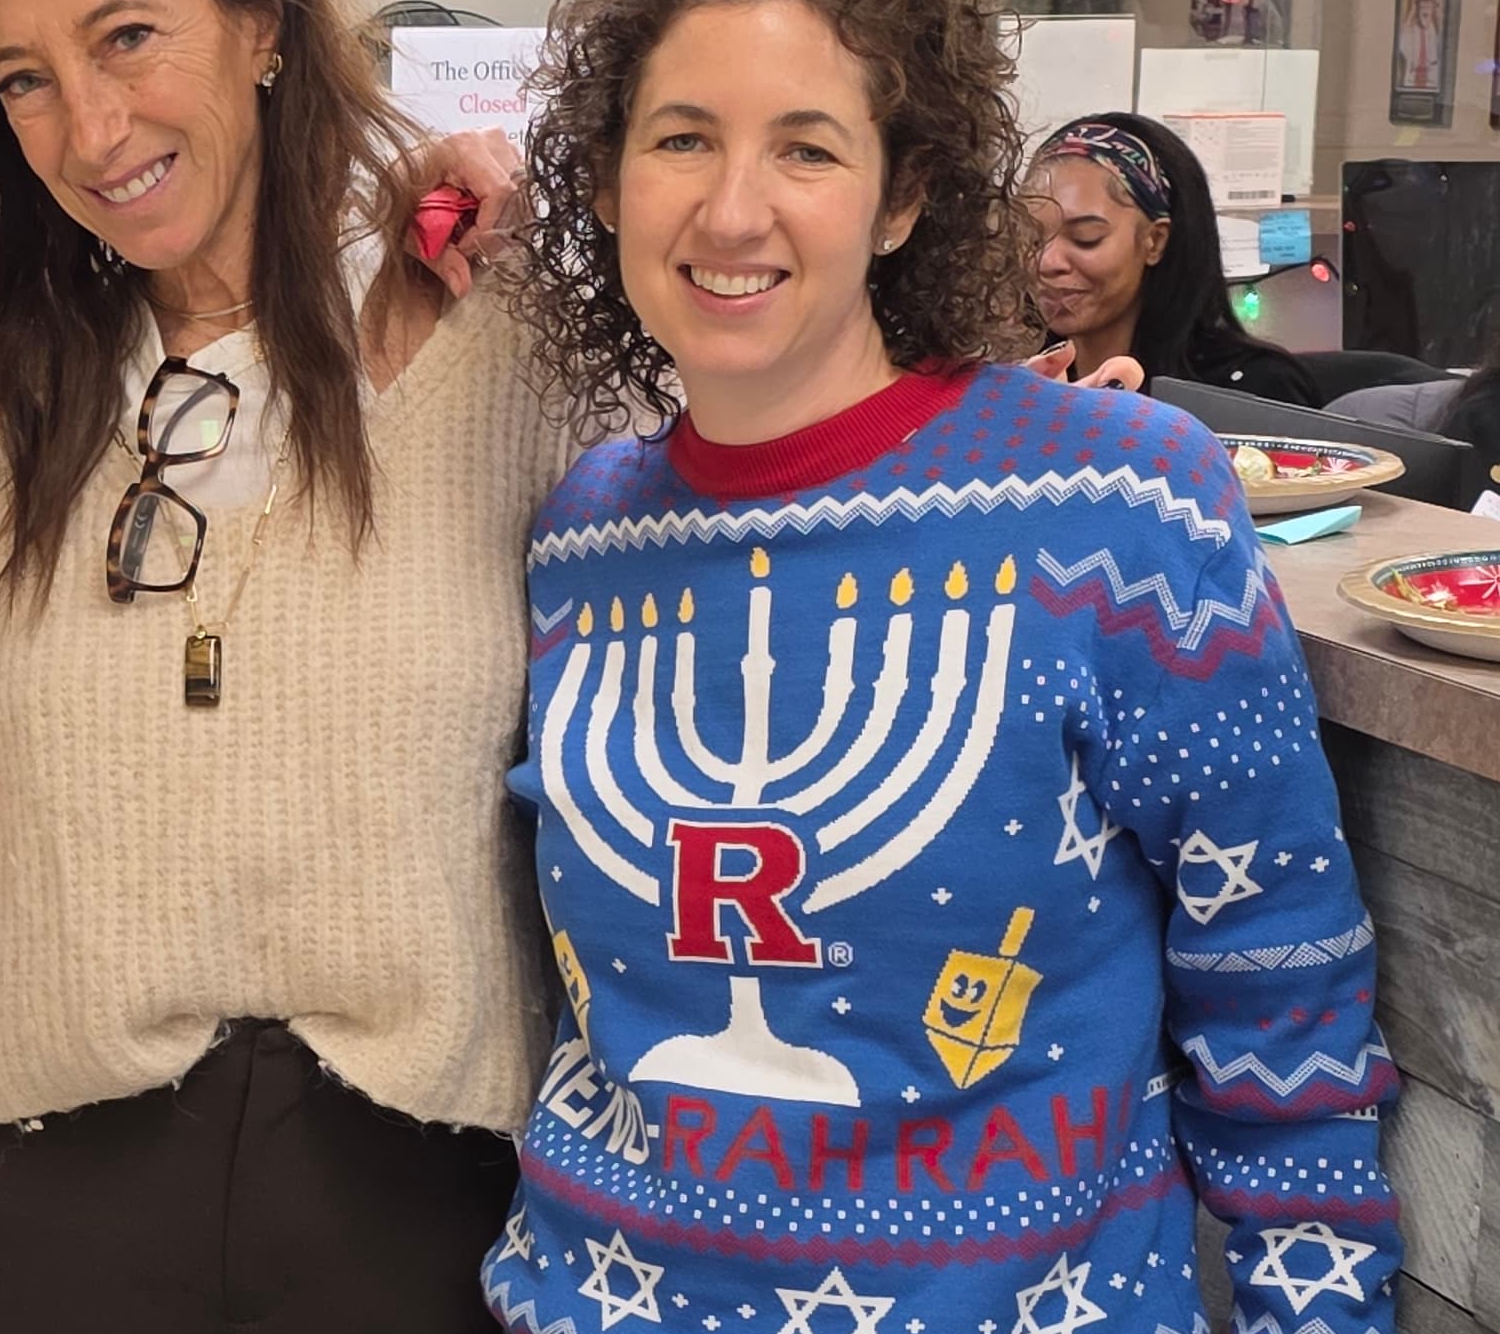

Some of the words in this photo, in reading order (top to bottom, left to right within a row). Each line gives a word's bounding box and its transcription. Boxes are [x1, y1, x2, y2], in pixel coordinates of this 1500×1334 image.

[430, 59, 469, 81] The
[459, 93, 527, 114] Closed
[666, 818, 824, 969] R
